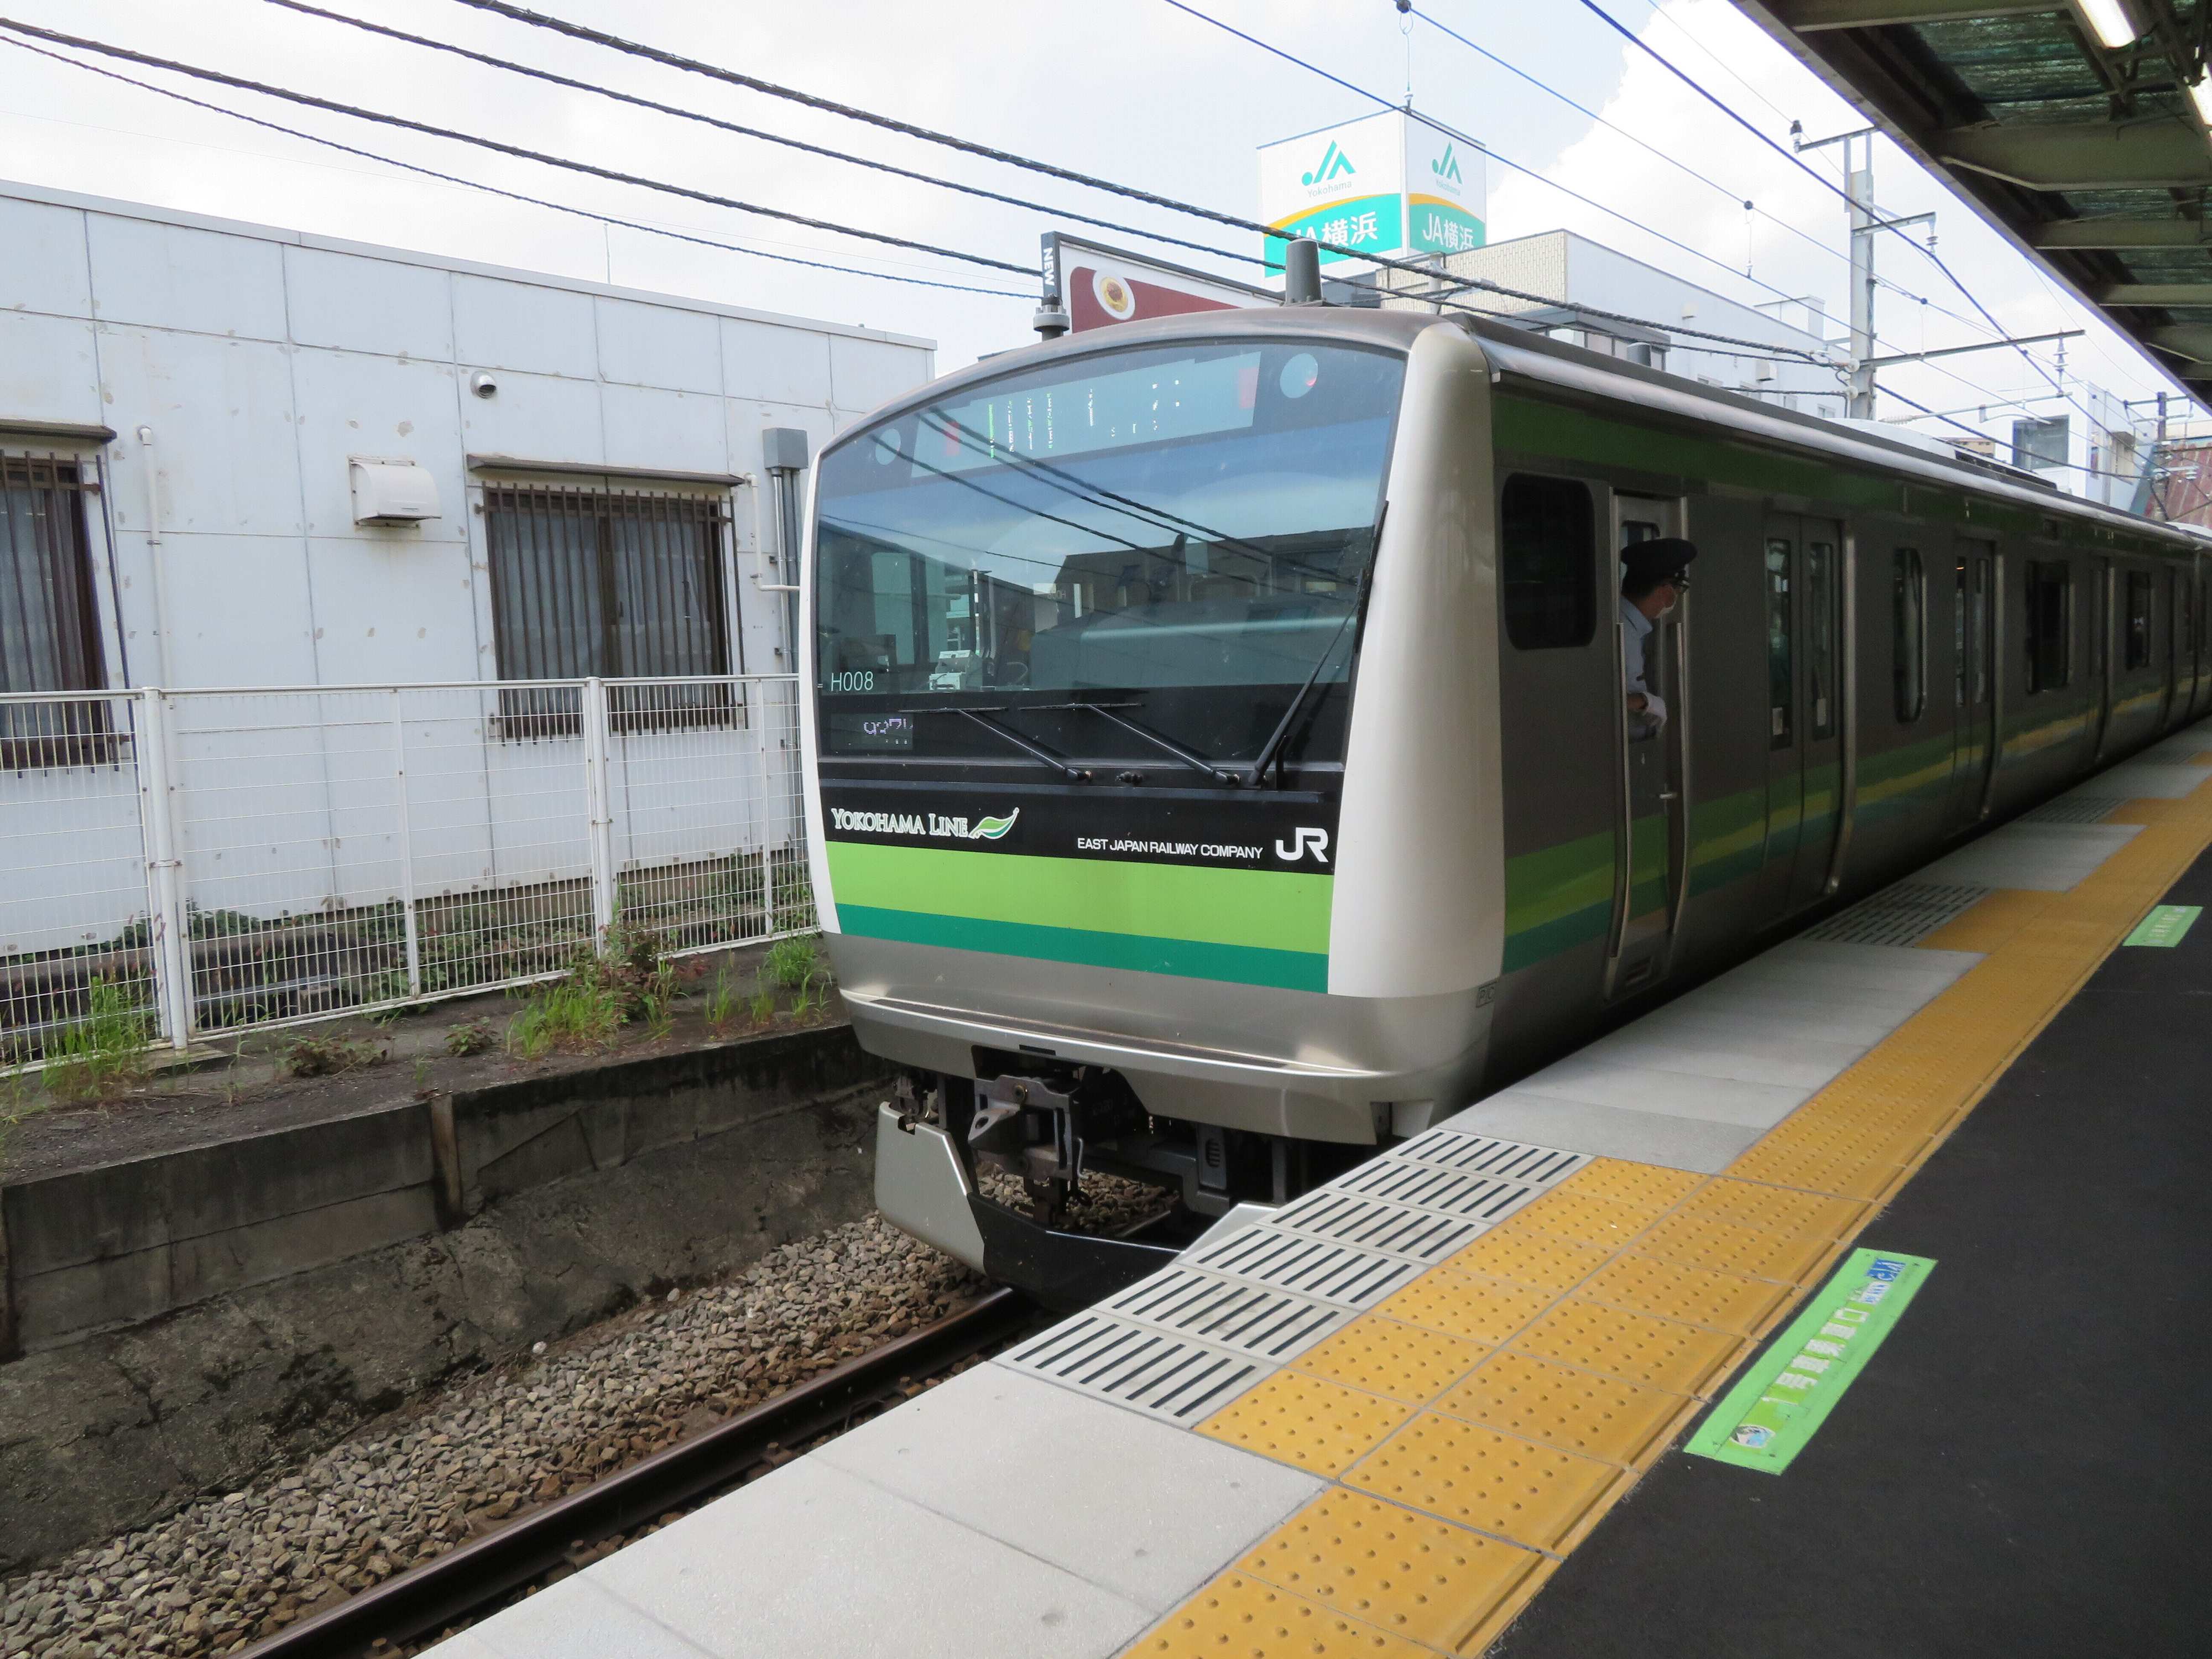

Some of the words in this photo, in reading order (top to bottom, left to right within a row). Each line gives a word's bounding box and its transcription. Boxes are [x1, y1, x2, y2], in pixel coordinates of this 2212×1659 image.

[1307, 181, 1352, 198] Yokohama
[1422, 213, 1474, 250] JA横浜
[1044, 247, 1055, 286] NEW
[831, 671, 874, 691] H008
[831, 808, 926, 836] YOKOHAMA
[928, 813, 968, 838] LINE
[1077, 837, 1108, 850] EAST
[1110, 840, 1148, 853] JAPAN
[1150, 841, 1198, 855] RAILWAY
[1200, 844, 1263, 859] COMPANY
[1276, 827, 1328, 863] JR
